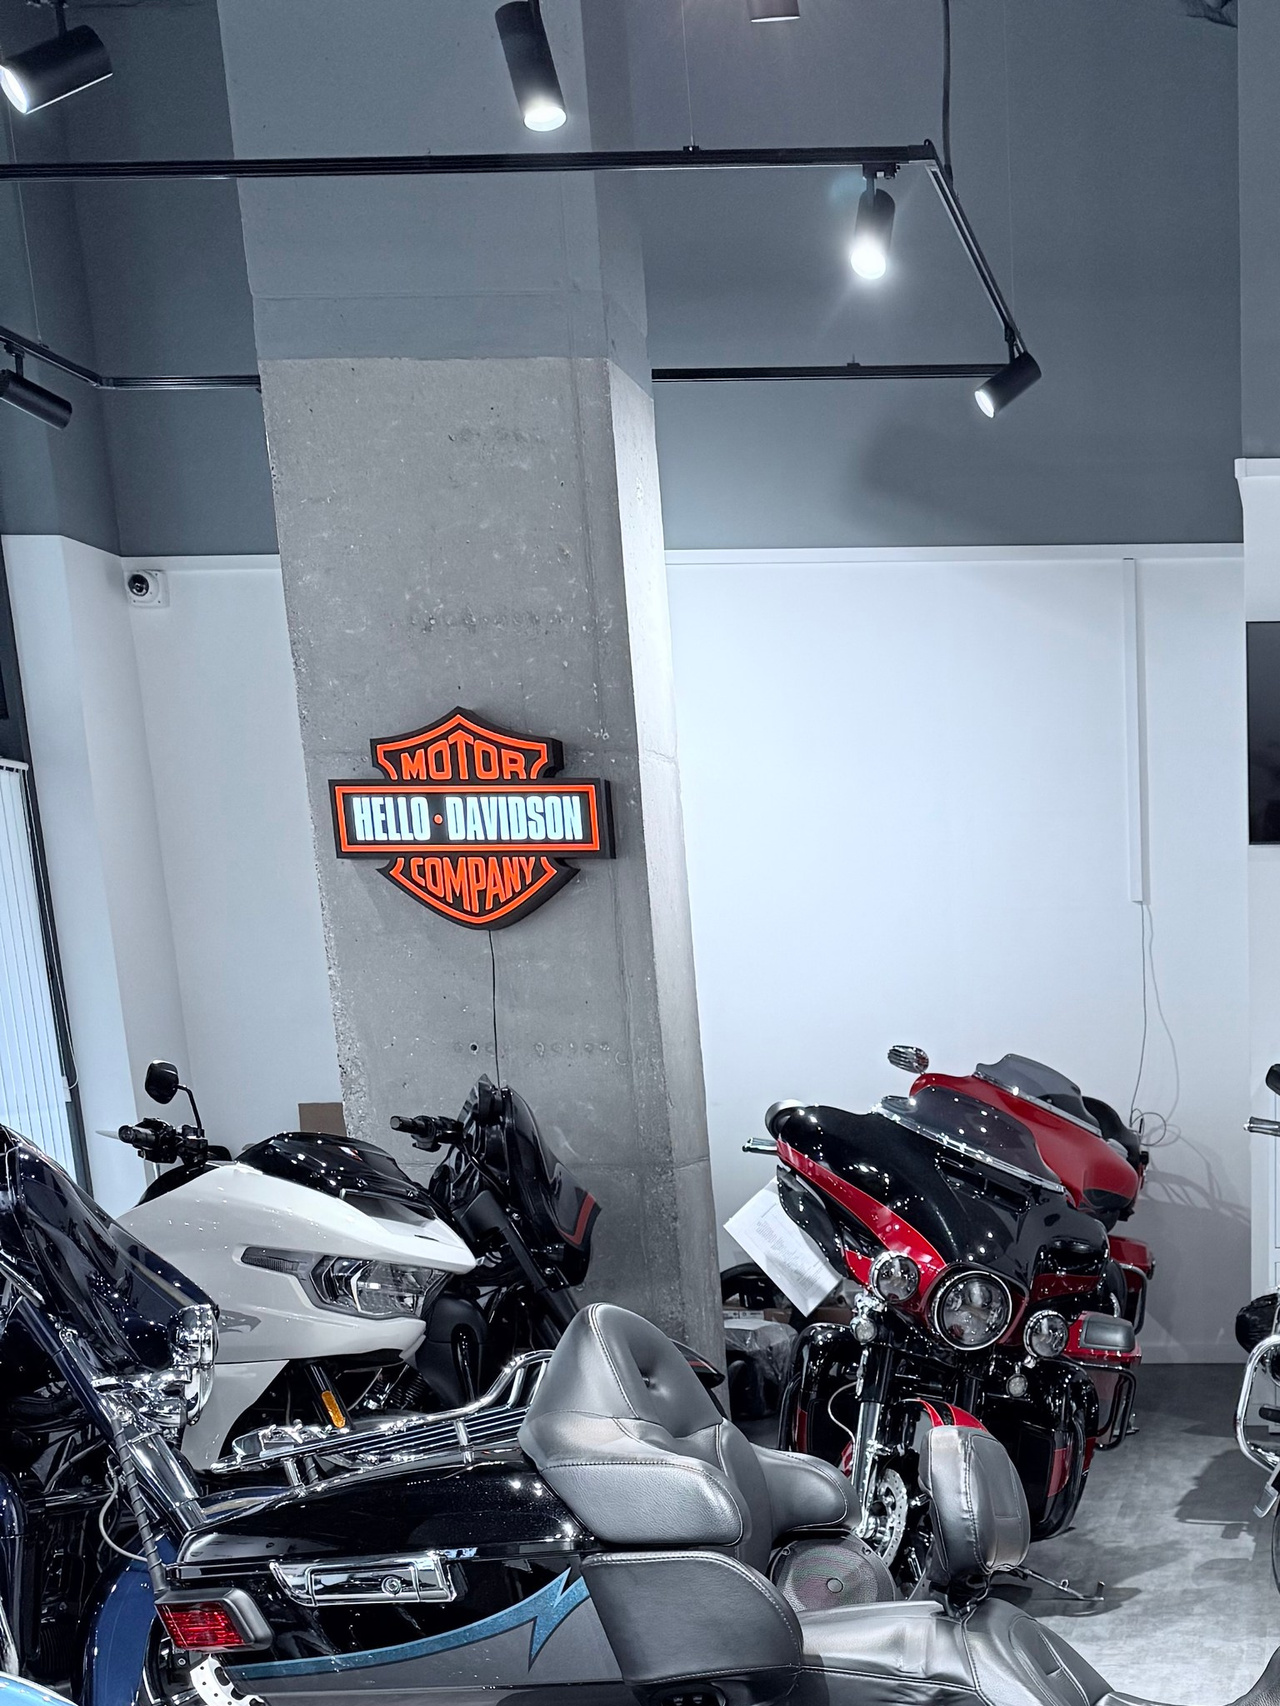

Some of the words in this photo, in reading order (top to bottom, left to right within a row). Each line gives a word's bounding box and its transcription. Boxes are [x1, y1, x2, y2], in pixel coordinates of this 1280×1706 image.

[400, 729, 527, 780] MOTOR
[352, 796, 431, 841] HELLO
[445, 795, 583, 841] DAVIDSON
[410, 857, 536, 914] COMPANY
